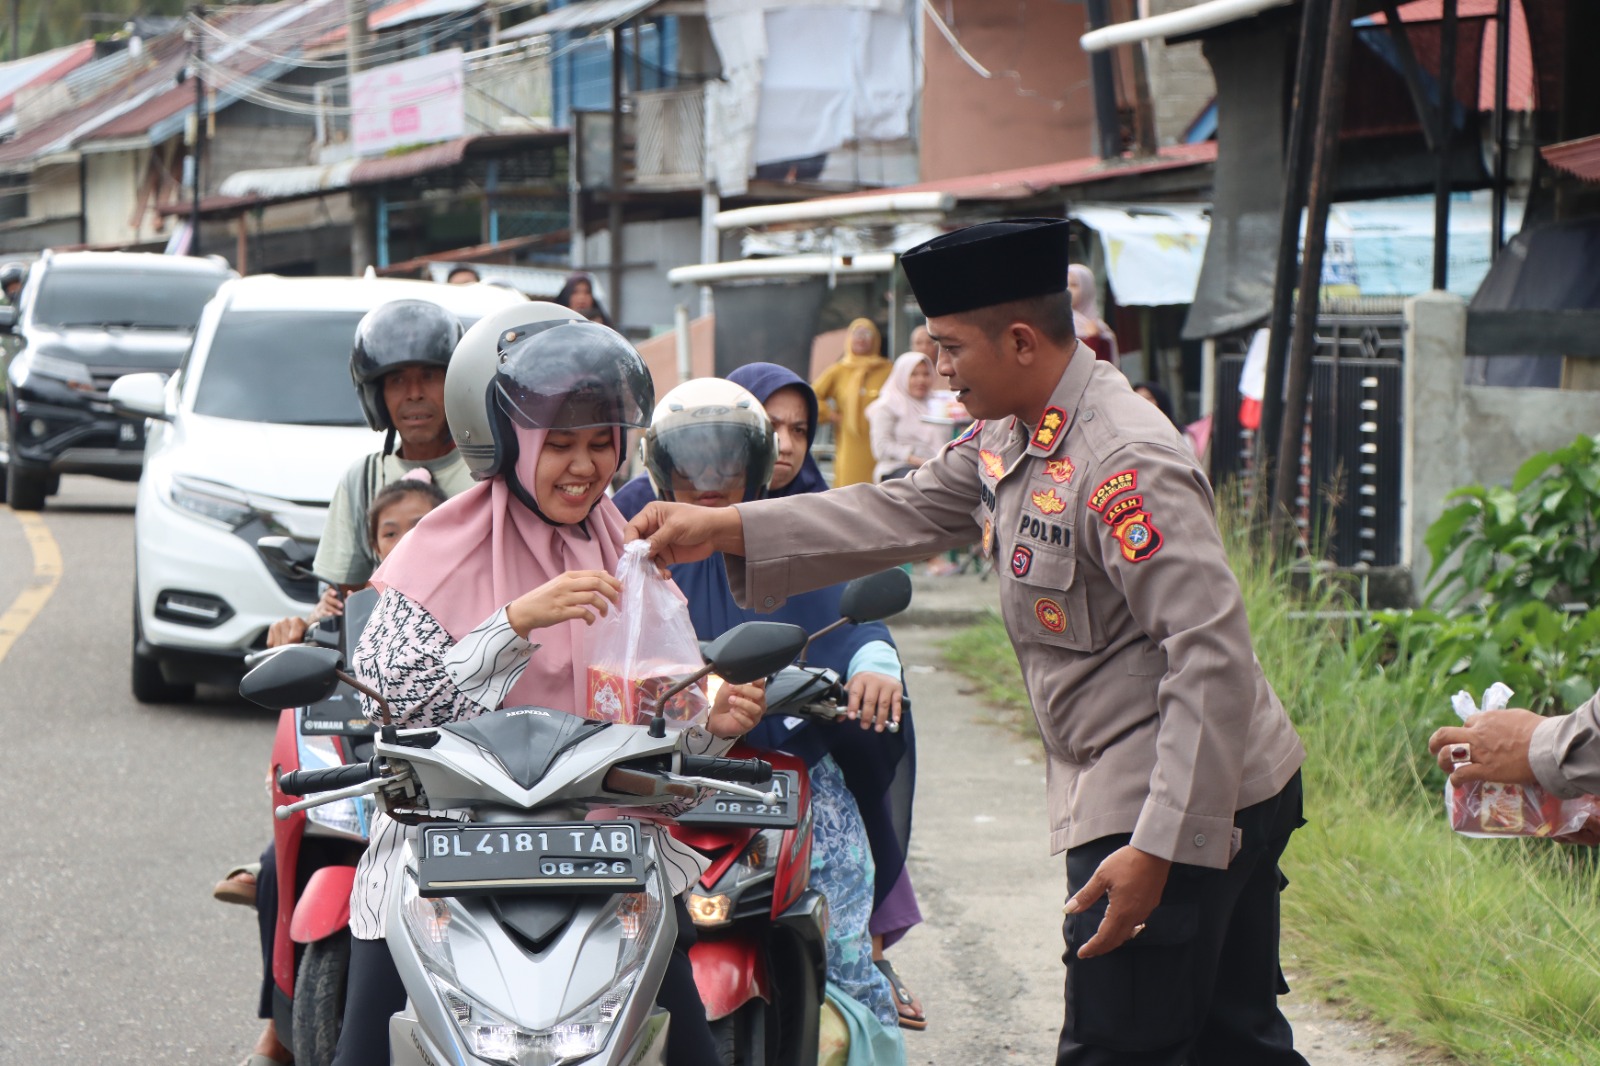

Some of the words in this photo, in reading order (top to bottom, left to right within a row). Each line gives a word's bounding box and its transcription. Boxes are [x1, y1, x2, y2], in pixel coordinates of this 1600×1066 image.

[1092, 473, 1133, 505] POLRES
[1109, 499, 1137, 520] ACEH
[1019, 515, 1070, 547] POLRI
[506, 709, 552, 718] HONDA
[313, 720, 344, 730] YAMAHA
[433, 835, 472, 856] BL
[476, 833, 549, 855] 4181
[570, 832, 628, 853] TAB
